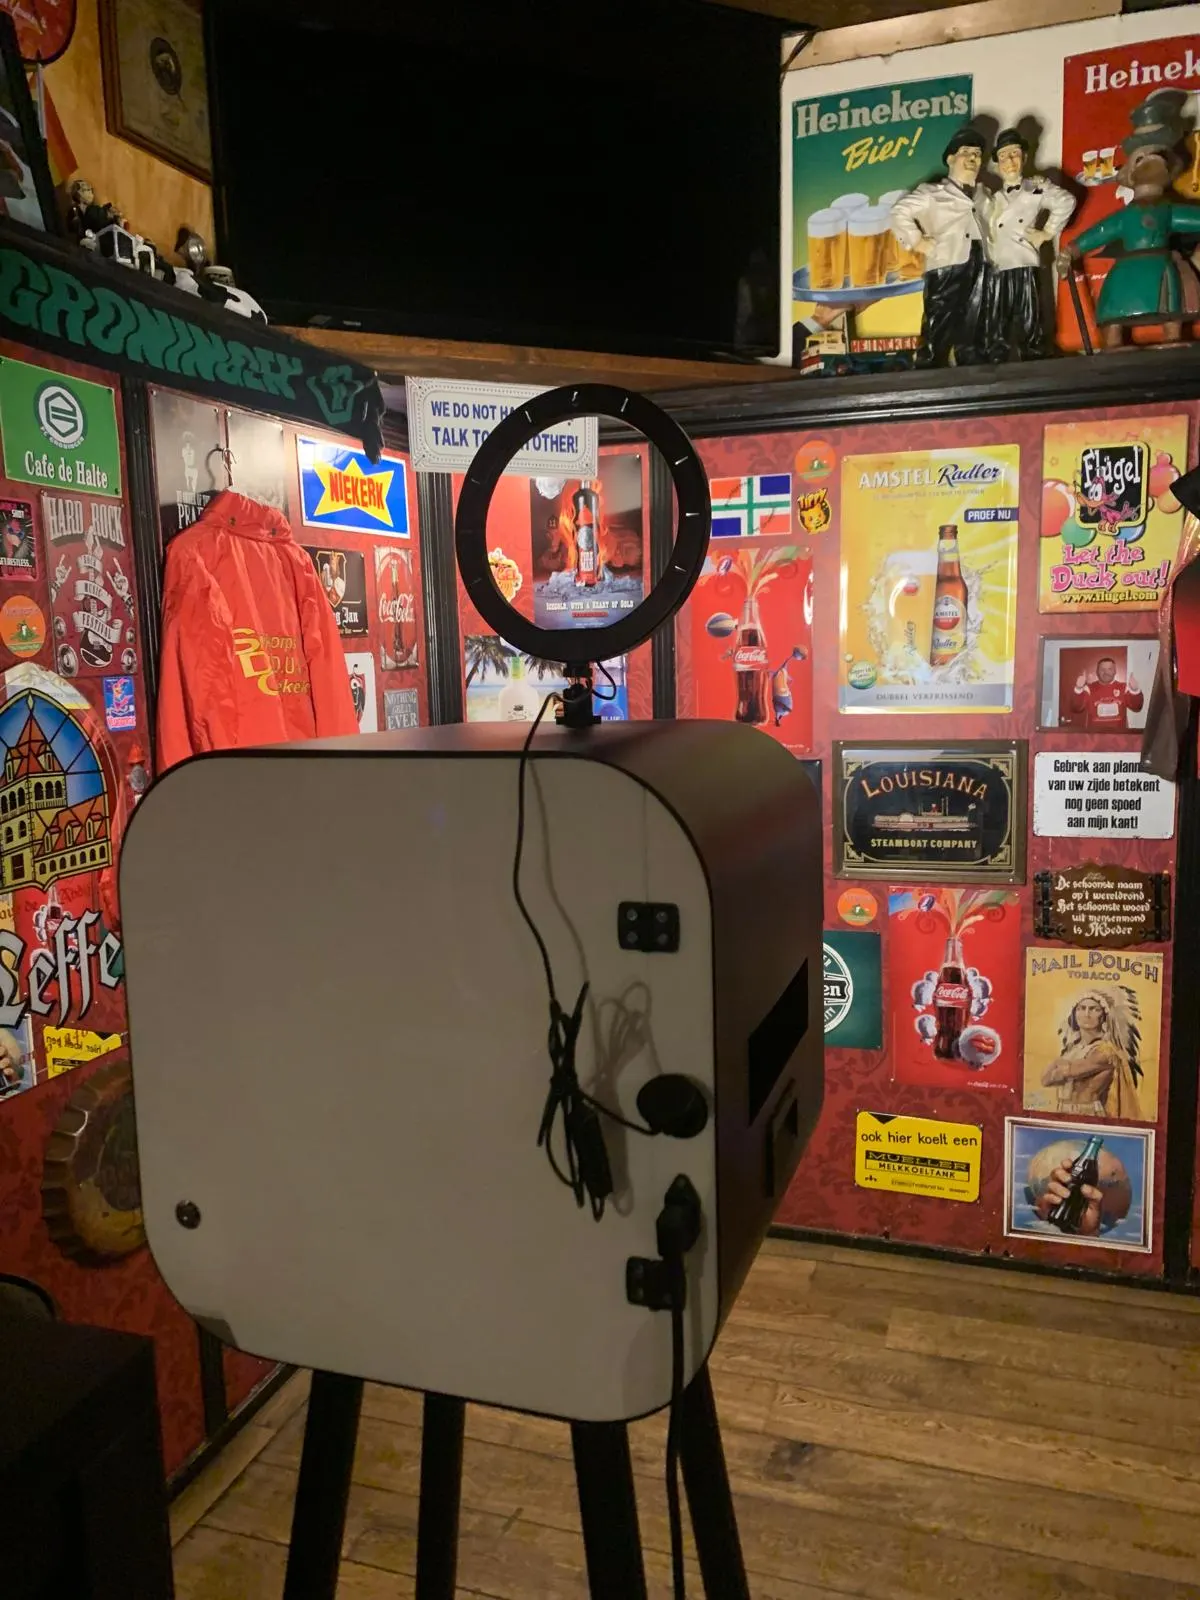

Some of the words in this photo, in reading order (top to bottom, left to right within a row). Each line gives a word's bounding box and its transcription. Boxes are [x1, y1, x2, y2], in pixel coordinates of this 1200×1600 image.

[796, 90, 969, 139] Heineken's
[842, 126, 923, 172] Bier!
[431, 400, 450, 417] WE
[453, 402, 470, 419] DO
[472, 403, 496, 420] NOT
[432, 427, 468, 447] TALK
[472, 428, 488, 448] TO
[533, 433, 578, 454] OTHER!
[24, 451, 55, 479] Cafe
[58, 457, 73, 483] de
[75, 460, 108, 488] Halte
[858, 467, 935, 489] AMSTEL
[936, 463, 1001, 488] Radler
[1082, 446, 1140, 494] Flügel
[329, 471, 386, 511] NIEKERK
[46, 496, 84, 541] HARD
[91, 503, 126, 548] ROCK
[967, 510, 996, 521] PROEF
[998, 509, 1012, 521] NU
[1063, 543, 1098, 566] Let
[1104, 539, 1144, 566] the
[1051, 565, 1116, 592] Duck
[1122, 560, 1171, 590] out!
[82, 613, 112, 640] FESTIVAL
[388, 713, 418, 731] EVER
[1054, 759, 1090, 773] Gebrek
[1092, 762, 1111, 772] aan
[1113, 760, 1143, 775] plann
[860, 769, 989, 800] LOUISIANA
[1048, 780, 1066, 791] van
[1068, 780, 1084, 791] uw
[1087, 778, 1111, 793] zijde
[1113, 778, 1161, 792] betekent
[1065, 798, 1083, 812] nog
[1085, 798, 1109, 812] geen
[1111, 797, 1142, 812] spoed
[1067, 816, 1085, 828] aan
[1087, 815, 1108, 830] mijn
[1111, 815, 1138, 829] kant!
[870, 838, 928, 848] STEAMBOAT
[930, 839, 977, 849] COMPANY
[1054, 875, 1071, 891] De
[1072, 877, 1114, 889] schoonste
[1117, 881, 1143, 889] naam
[1092, 890, 1145, 900] wereldrond
[1056, 899, 1074, 914] Het
[1077, 901, 1120, 912] schoonste
[1123, 902, 1150, 912] woord
[1072, 914, 1086, 922] uit
[1073, 925, 1082, 935] is
[1085, 922, 1133, 937] Moeder
[1032, 954, 1082, 976] MAIL
[1088, 951, 1159, 983] POUCH
[1067, 969, 1121, 982] TOBACCO
[861, 1130, 882, 1143] ook
[888, 1131, 912, 1144] hier
[918, 1132, 948, 1146] koelt
[953, 1137, 978, 1147] een
[868, 1151, 968, 1171] MUELLER
[878, 1162, 956, 1179] MELKKOELTANK
